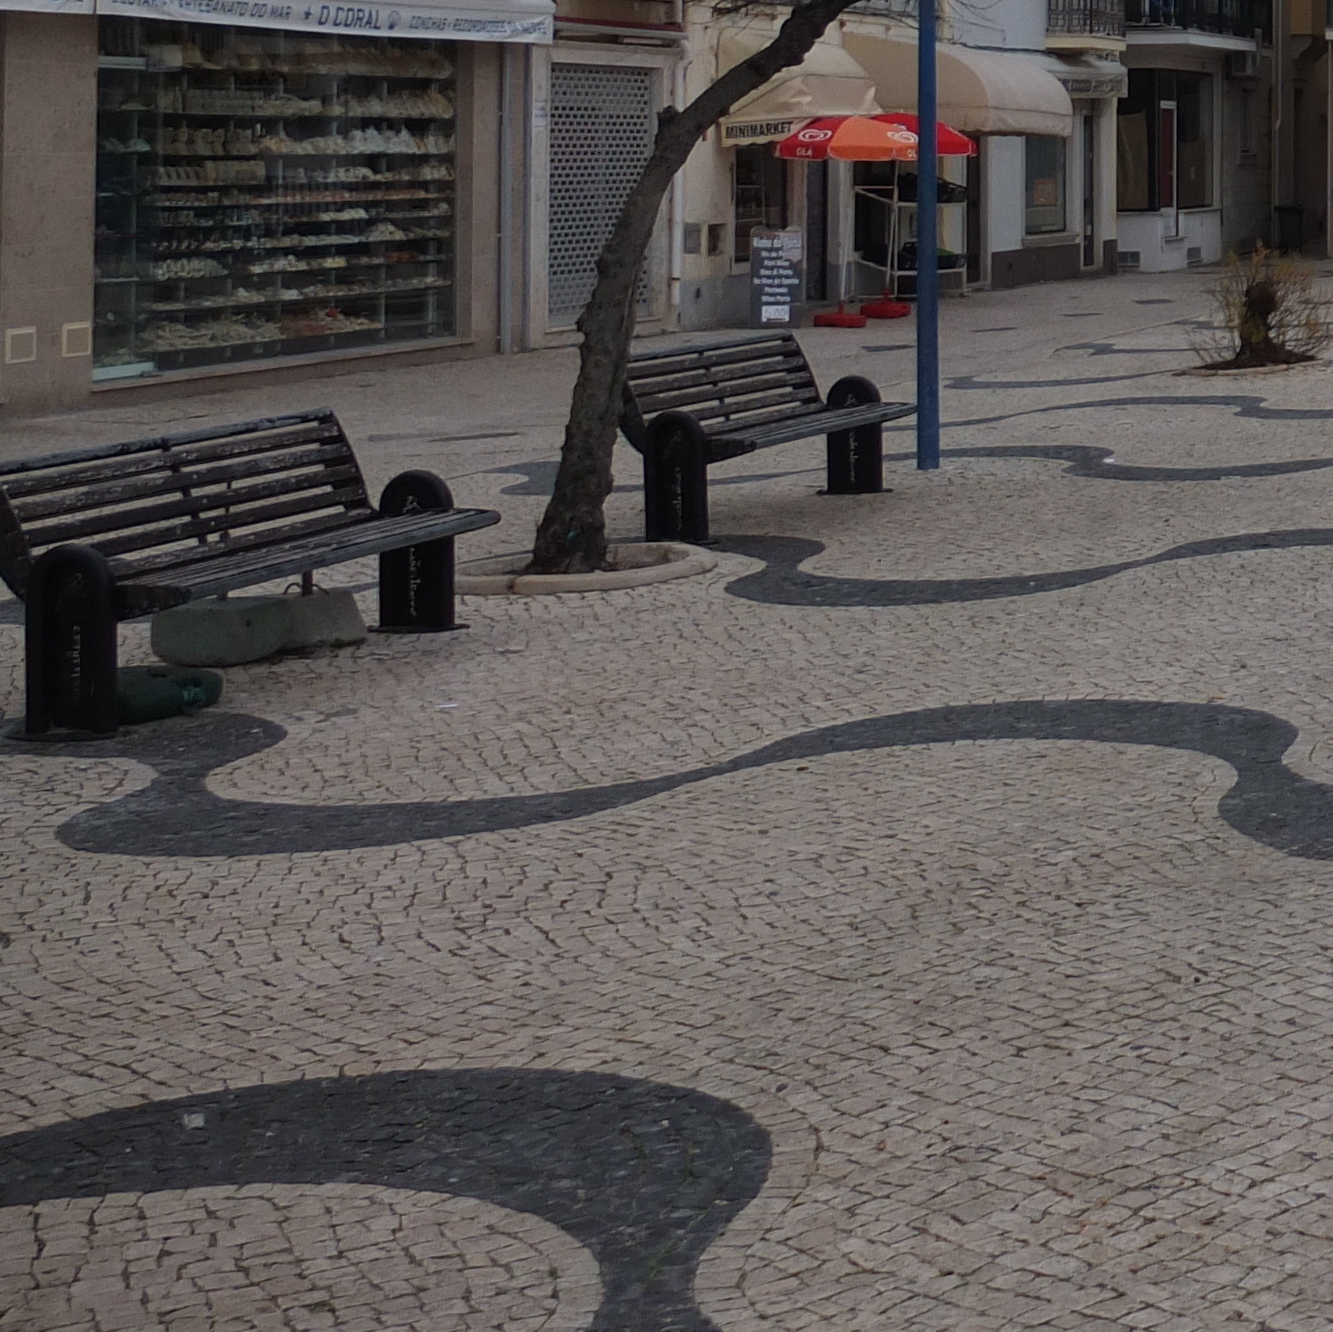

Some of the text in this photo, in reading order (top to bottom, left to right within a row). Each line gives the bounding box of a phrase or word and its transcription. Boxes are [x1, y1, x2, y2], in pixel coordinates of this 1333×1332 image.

[269, 4, 293, 21] MAR
[318, 5, 382, 30] O CORAL
[725, 121, 794, 140] MINIMARKET
